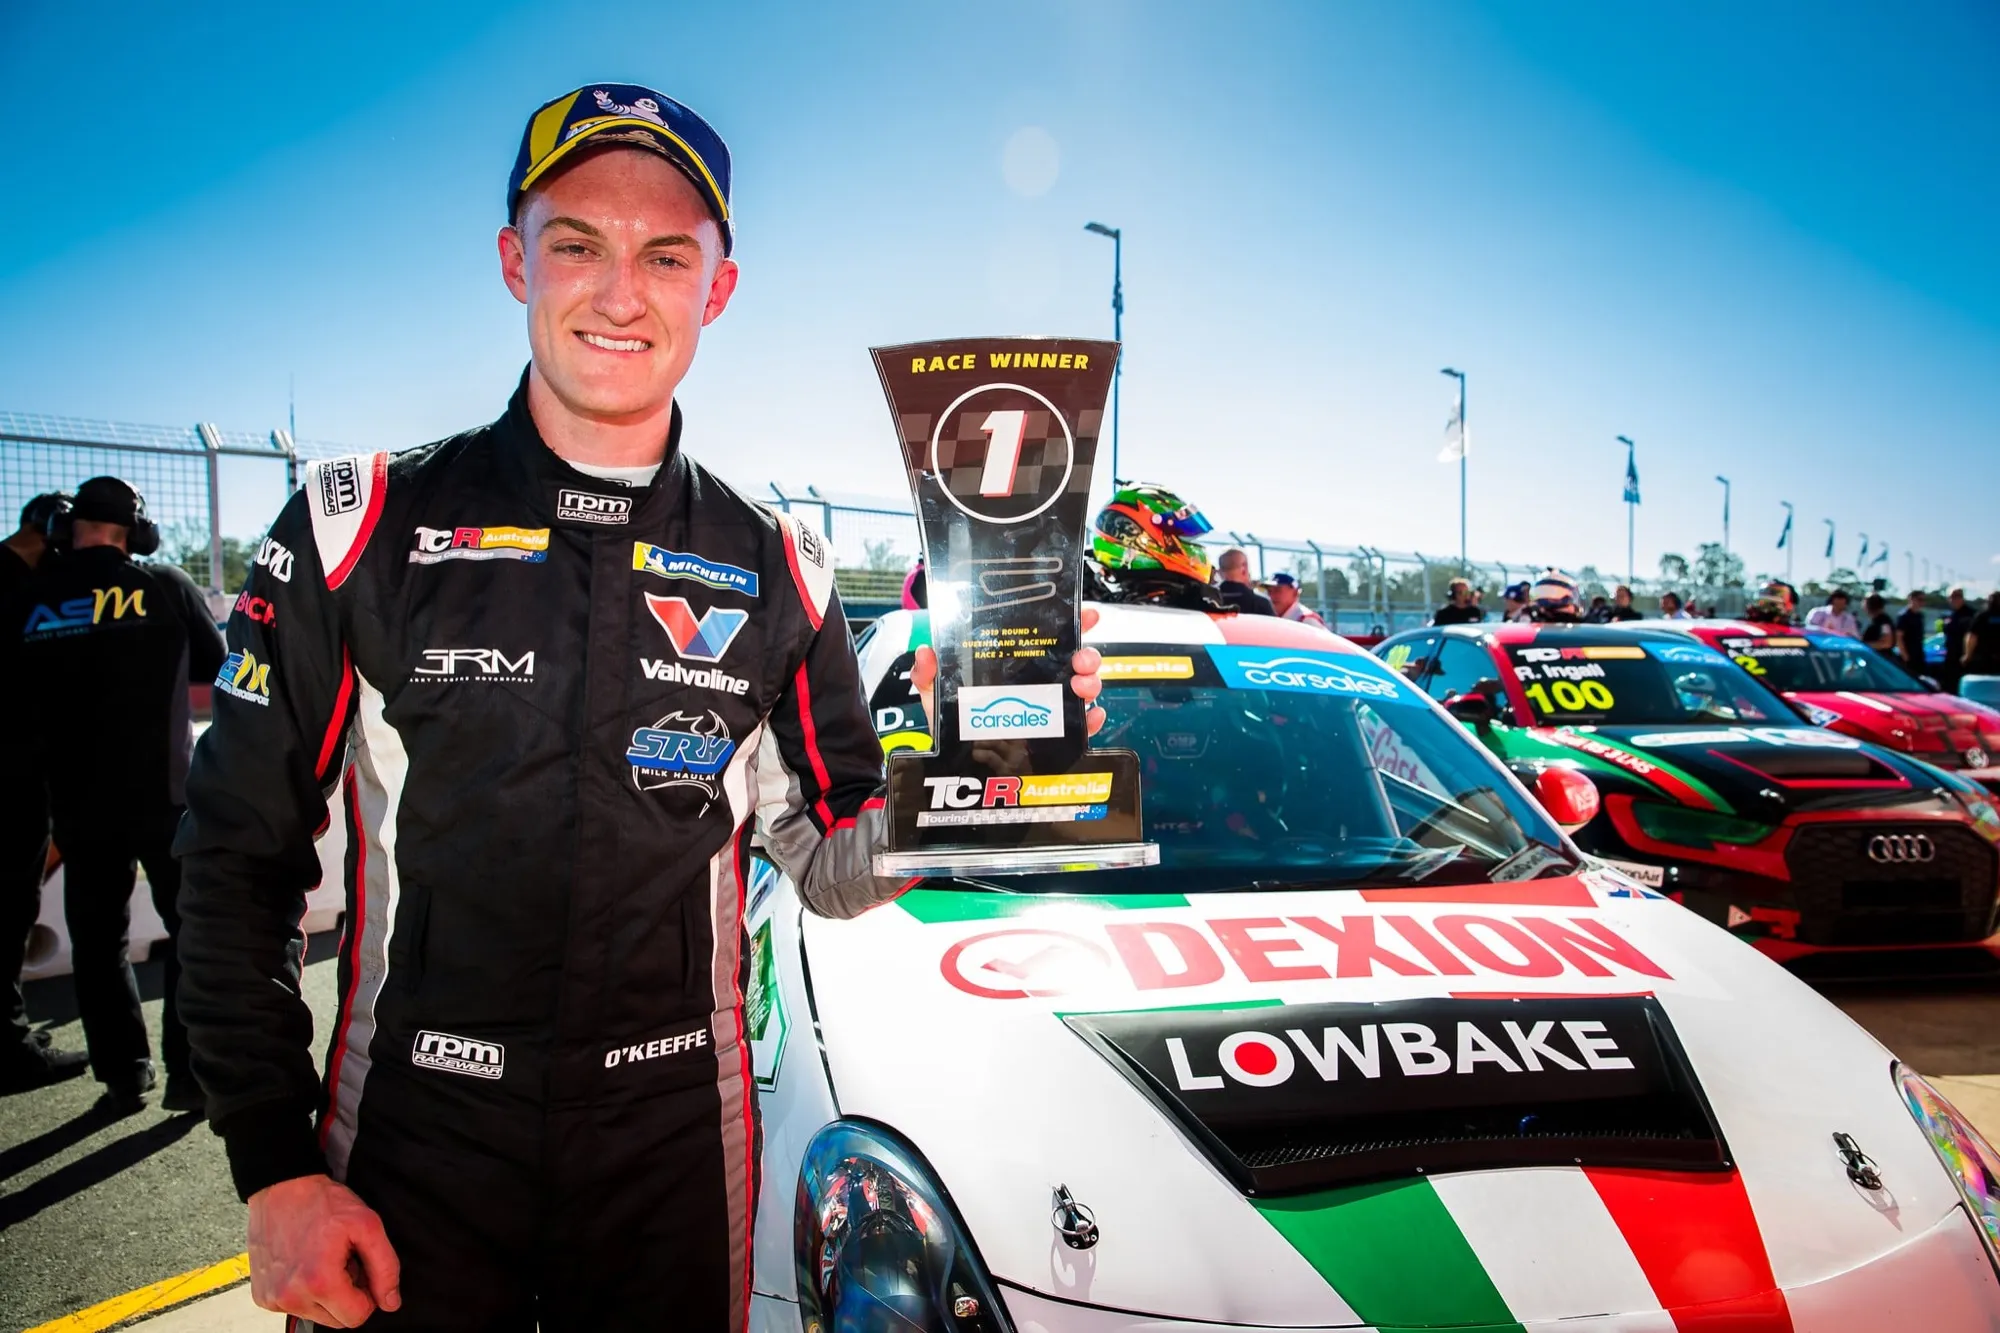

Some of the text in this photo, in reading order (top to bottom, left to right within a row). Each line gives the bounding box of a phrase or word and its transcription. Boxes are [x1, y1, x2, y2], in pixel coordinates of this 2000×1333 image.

[911, 353, 1090, 373] RACE WINNER
[979, 410, 1028, 497] 1
[333, 461, 357, 508] rpm
[565, 493, 627, 512] rpm
[560, 510, 627, 522] RACEWEAR
[415, 526, 482, 552] TCR
[443, 551, 461, 559] Car
[668, 562, 748, 586] MICHELIN
[1002, 628, 1030, 636] ROUND
[1032, 627, 1038, 635] 4
[1018, 638, 1058, 647] RACEWAY
[974, 651, 996, 659] RACE
[1013, 650, 1046, 658] WINNER
[640, 658, 750, 696] Valvoline
[1245, 670, 1400, 699] carsales
[1514, 666, 1542, 682] R.
[1526, 680, 1615, 714] 100
[877, 706, 915, 733] D.
[970, 709, 1049, 729] carsales
[641, 768, 668, 777] MILK
[923, 776, 1108, 809] TCR Australia
[925, 813, 970, 825] Touring
[974, 812, 996, 822] Car
[1104, 914, 1674, 991] DEXION
[420, 1033, 499, 1064] rpm
[605, 1028, 707, 1069] O'KEEFFE
[1165, 1020, 1635, 1091] LOWBAKE
[415, 1054, 502, 1074] RACEWEAR
